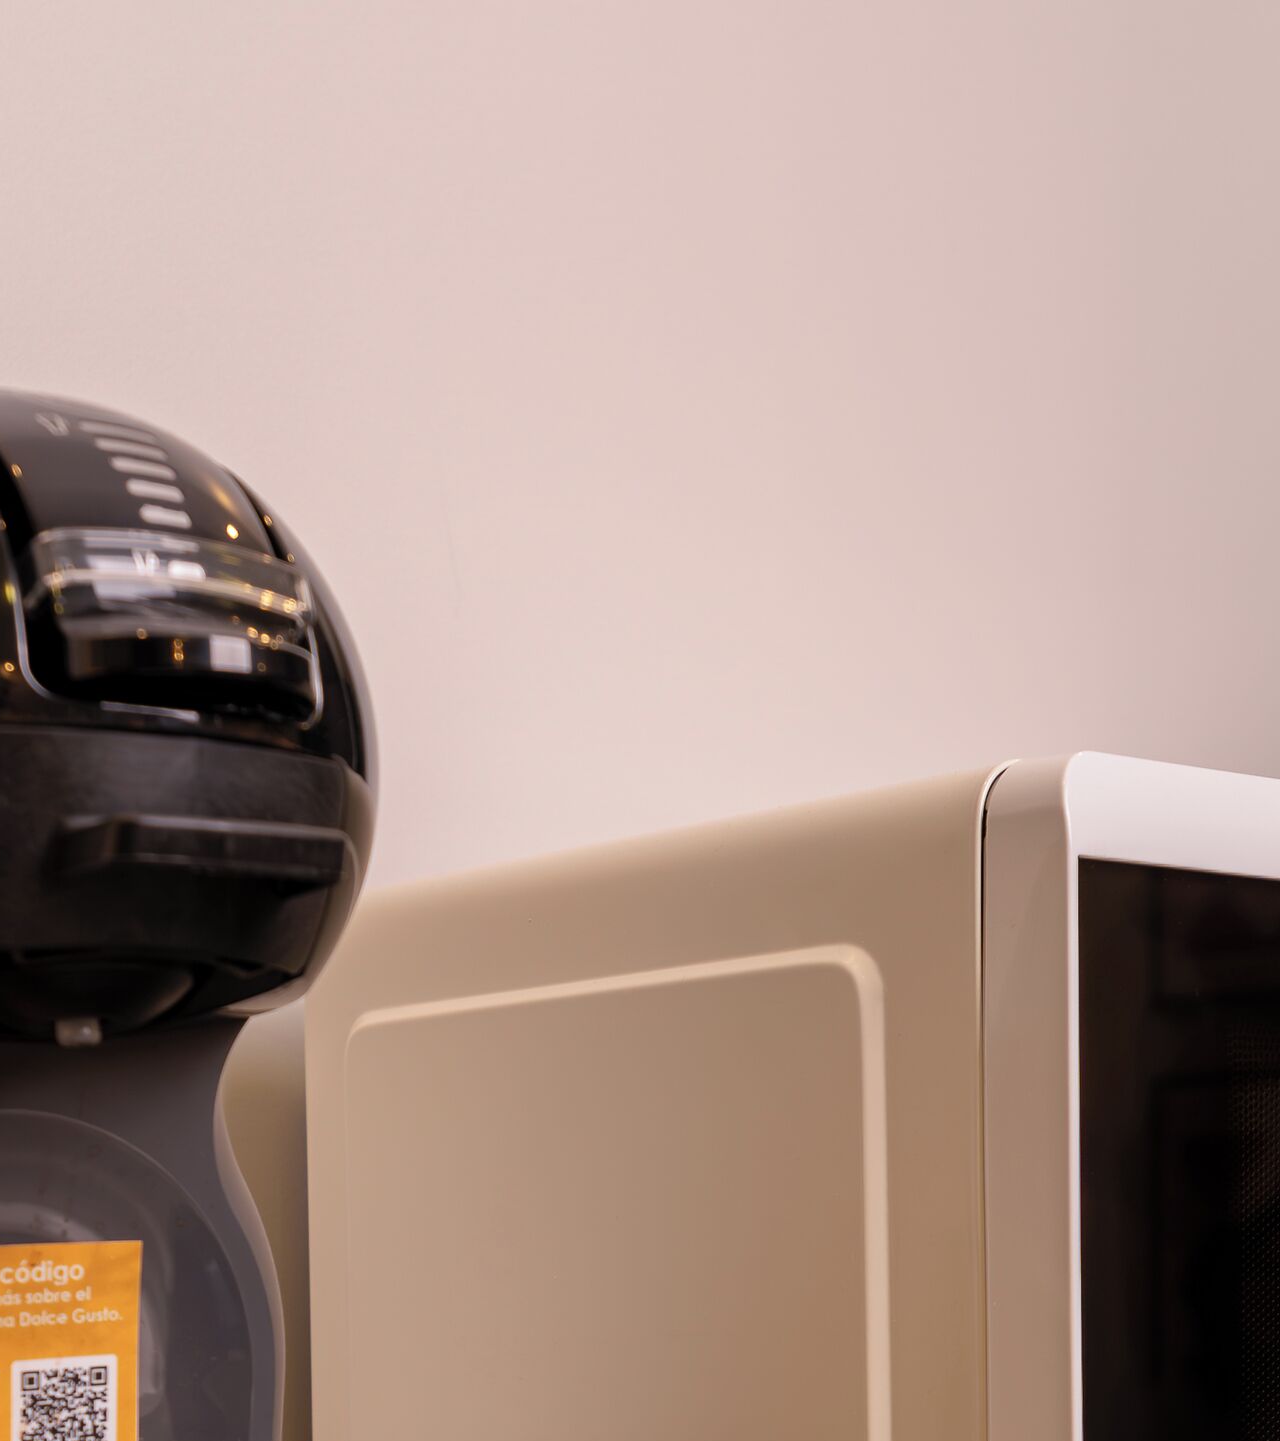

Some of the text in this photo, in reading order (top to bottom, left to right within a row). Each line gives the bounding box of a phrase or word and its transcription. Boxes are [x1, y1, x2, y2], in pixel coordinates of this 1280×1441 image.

[25, 1287, 71, 1304] sobre
[75, 1285, 92, 1301] el
[19, 1310, 68, 1327] Dolce
[71, 1307, 123, 1324] Gusto.
